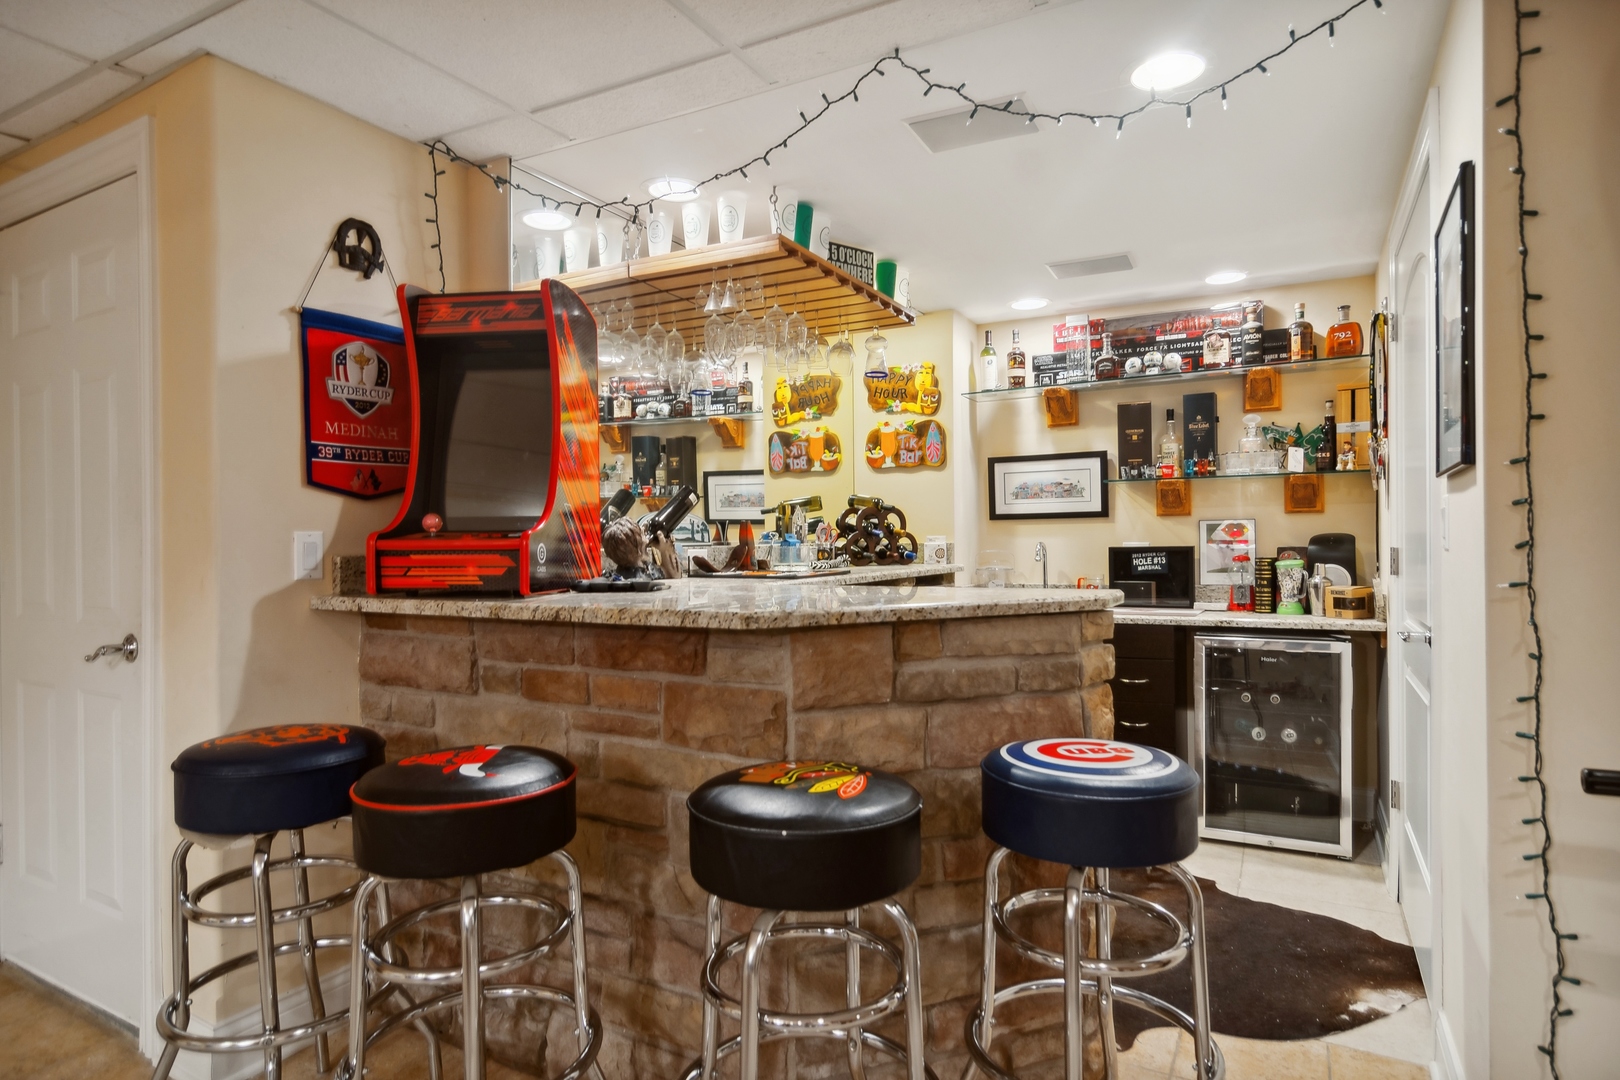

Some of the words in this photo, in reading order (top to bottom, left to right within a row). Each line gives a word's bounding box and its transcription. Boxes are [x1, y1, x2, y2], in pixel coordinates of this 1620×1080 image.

[831, 244, 838, 261] 5
[839, 246, 873, 269] O'CLOCK
[1092, 348, 1133, 357] SKYALKER
[1136, 345, 1158, 353] FORCE
[1170, 340, 1203, 349] LIGHTSAB
[332, 384, 368, 397] RYDER
[369, 388, 391, 400] CUP
[873, 386, 908, 399] HOUR
[324, 420, 399, 440] MEDINAH
[345, 448, 384, 462] RYDER
[388, 451, 410, 463] CUP
[1132, 556, 1153, 566] HOLE
[1153, 556, 1166, 565] #13
